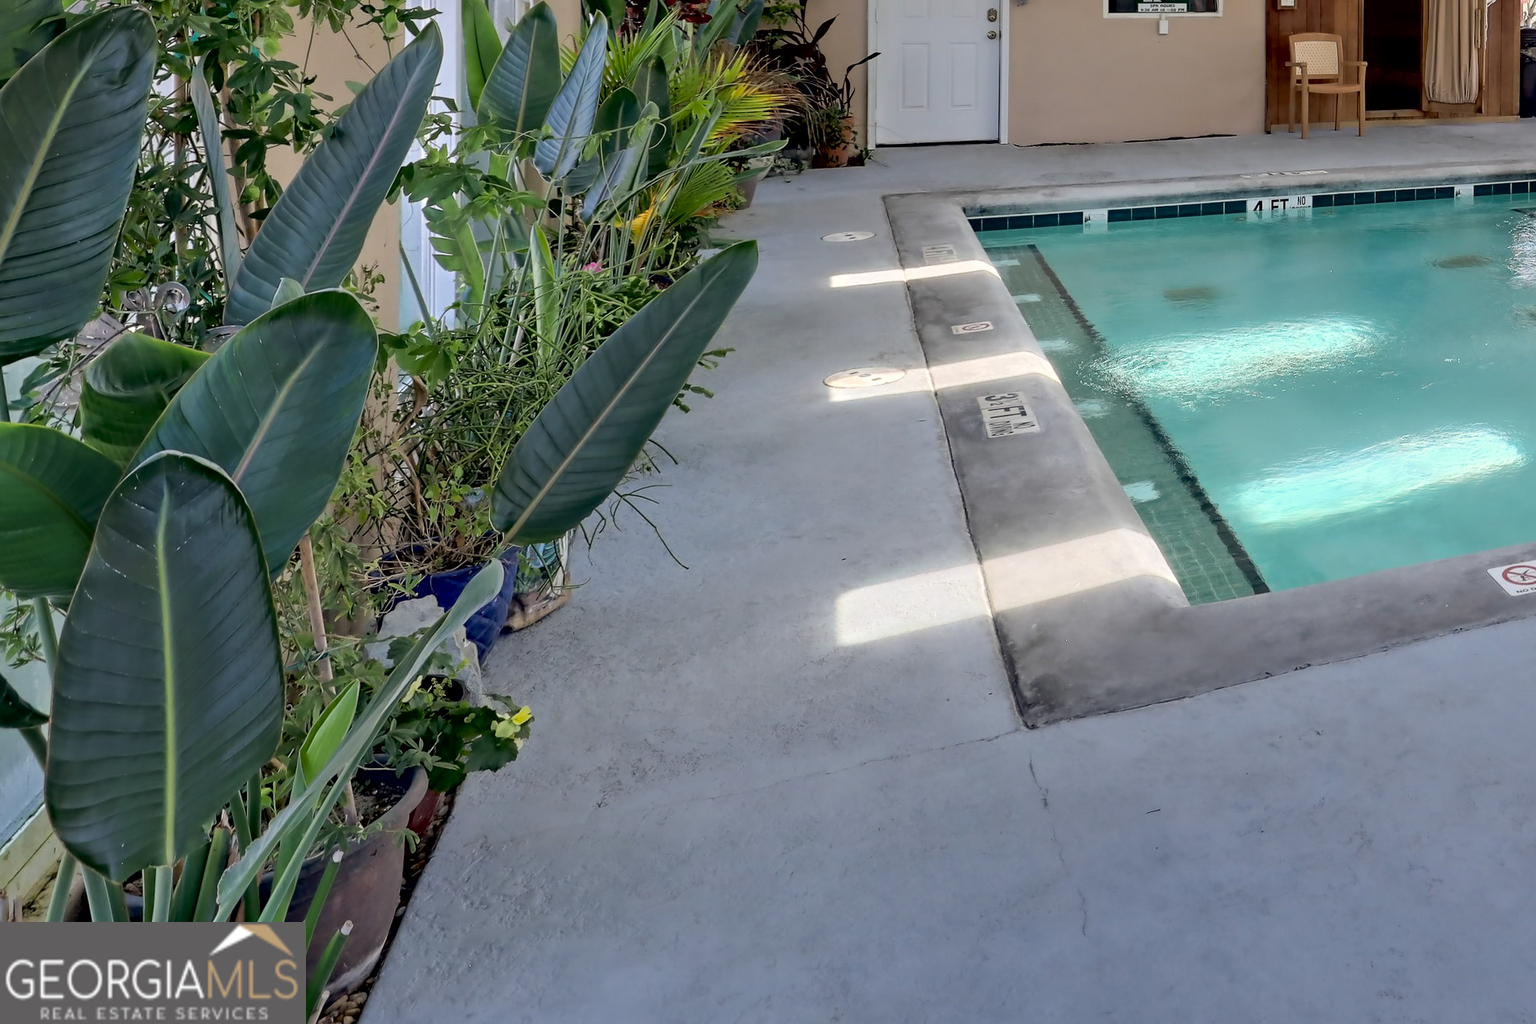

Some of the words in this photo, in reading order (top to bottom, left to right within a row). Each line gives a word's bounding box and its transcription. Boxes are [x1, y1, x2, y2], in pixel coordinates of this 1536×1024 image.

[1271, 198, 1289, 211] FT
[1297, 196, 1306, 205] NO
[988, 405, 1027, 419] FT
